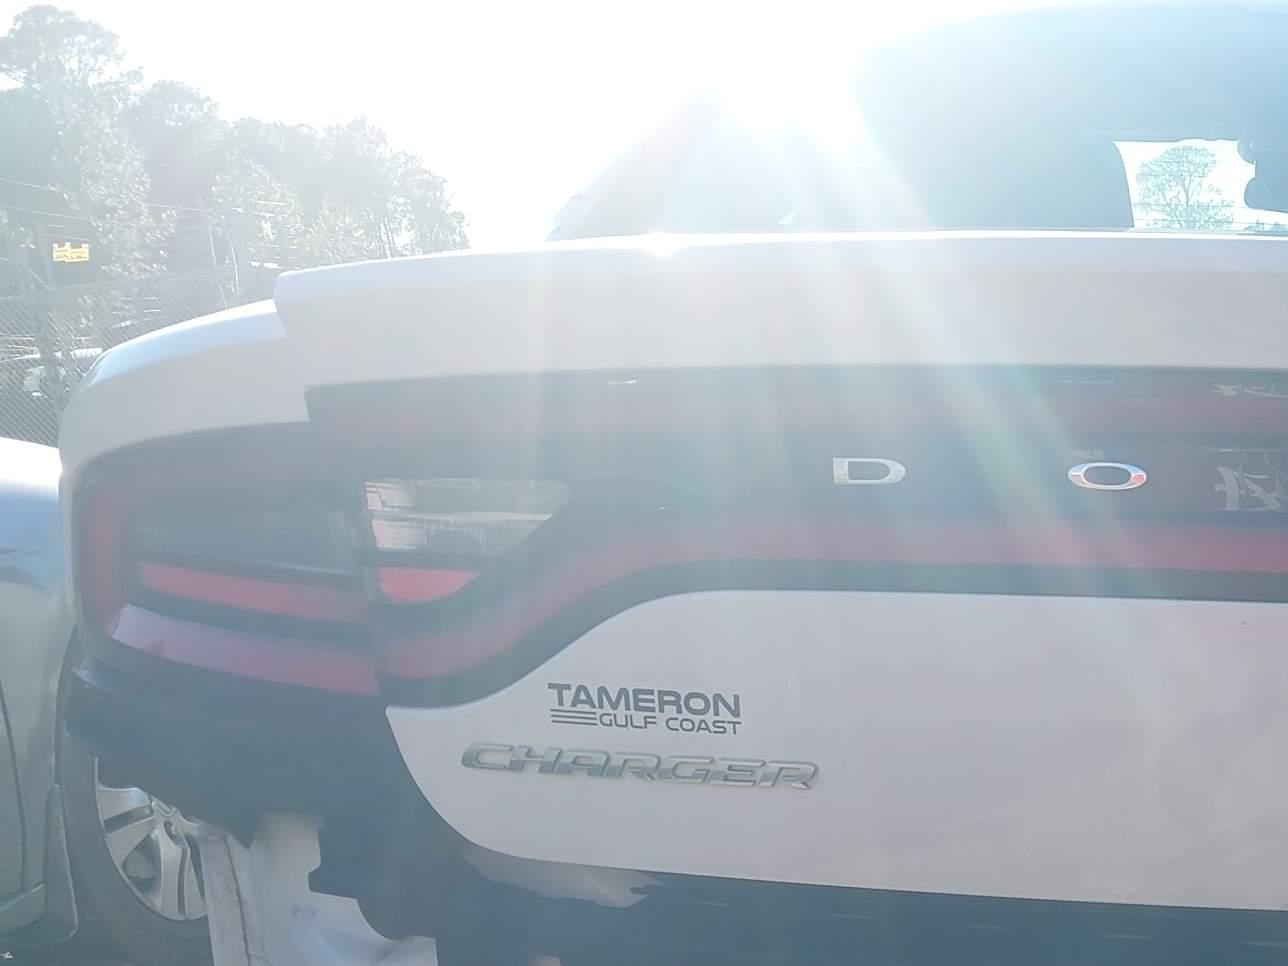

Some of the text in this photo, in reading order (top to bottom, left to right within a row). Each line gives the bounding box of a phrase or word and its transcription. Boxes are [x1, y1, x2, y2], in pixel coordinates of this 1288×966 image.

[548, 683, 741, 718] TAMERON
[599, 712, 741, 735] GULF COAST
[461, 742, 819, 790] CHARGER
